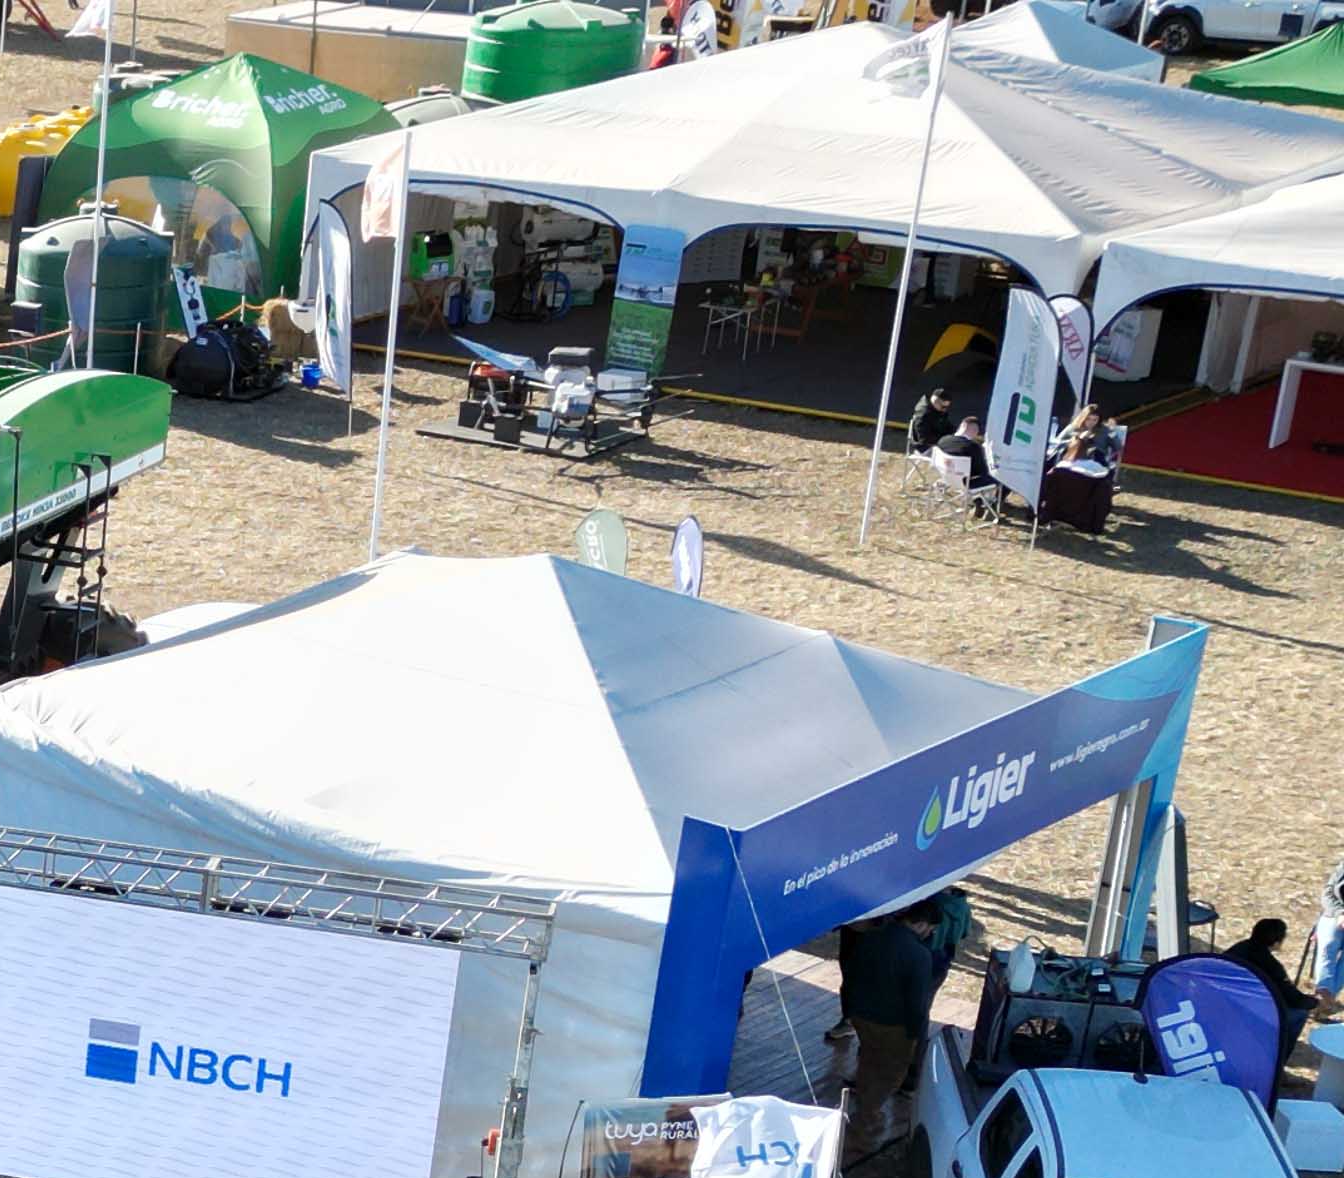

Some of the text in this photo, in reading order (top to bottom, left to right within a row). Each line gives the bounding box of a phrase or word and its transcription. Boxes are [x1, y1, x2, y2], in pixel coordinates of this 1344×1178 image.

[941, 751, 1036, 830] Ligier
[783, 879, 797, 896] En
[148, 1041, 293, 1098] NBCH
[604, 1120, 659, 1145] tuya
